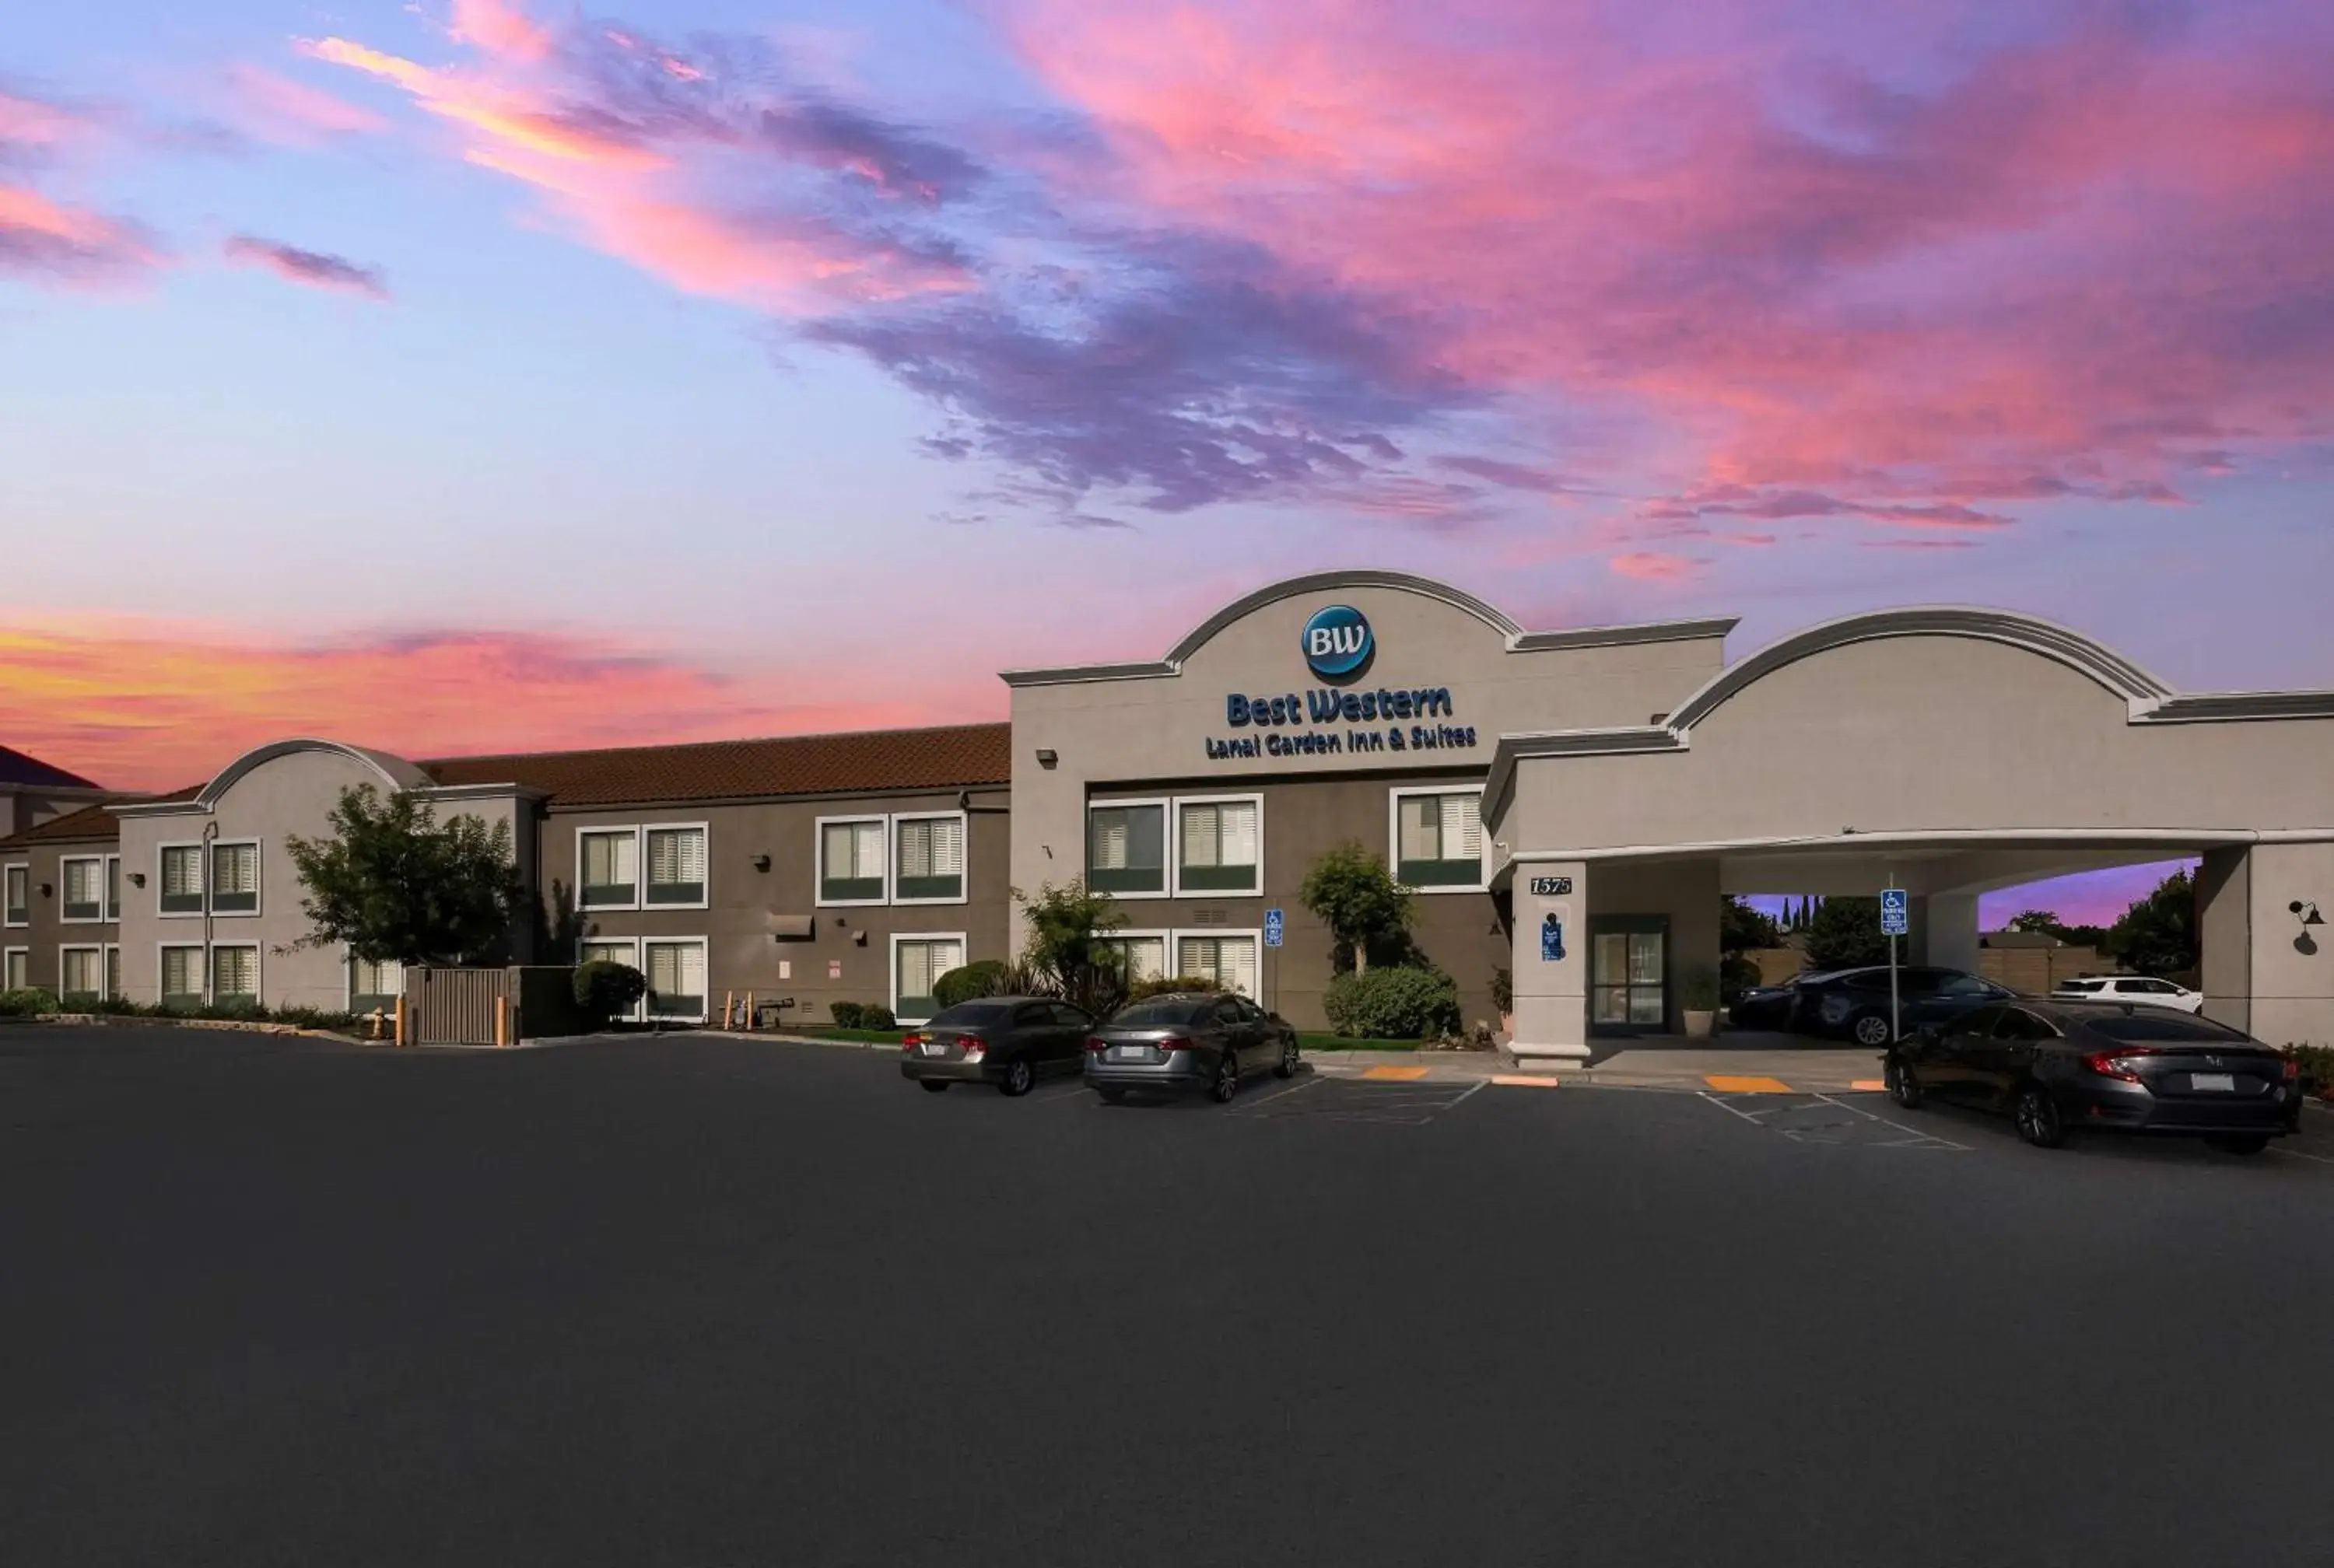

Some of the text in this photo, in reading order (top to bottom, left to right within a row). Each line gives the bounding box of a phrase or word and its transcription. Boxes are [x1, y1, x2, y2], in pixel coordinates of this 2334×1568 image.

[1310, 625, 1365, 656] BW
[1227, 686, 1453, 727] Best Western
[1265, 730, 1342, 757] Garden
[1347, 729, 1384, 752] Inn
[1388, 726, 1406, 751] &
[1532, 878, 1571, 894] 1575
